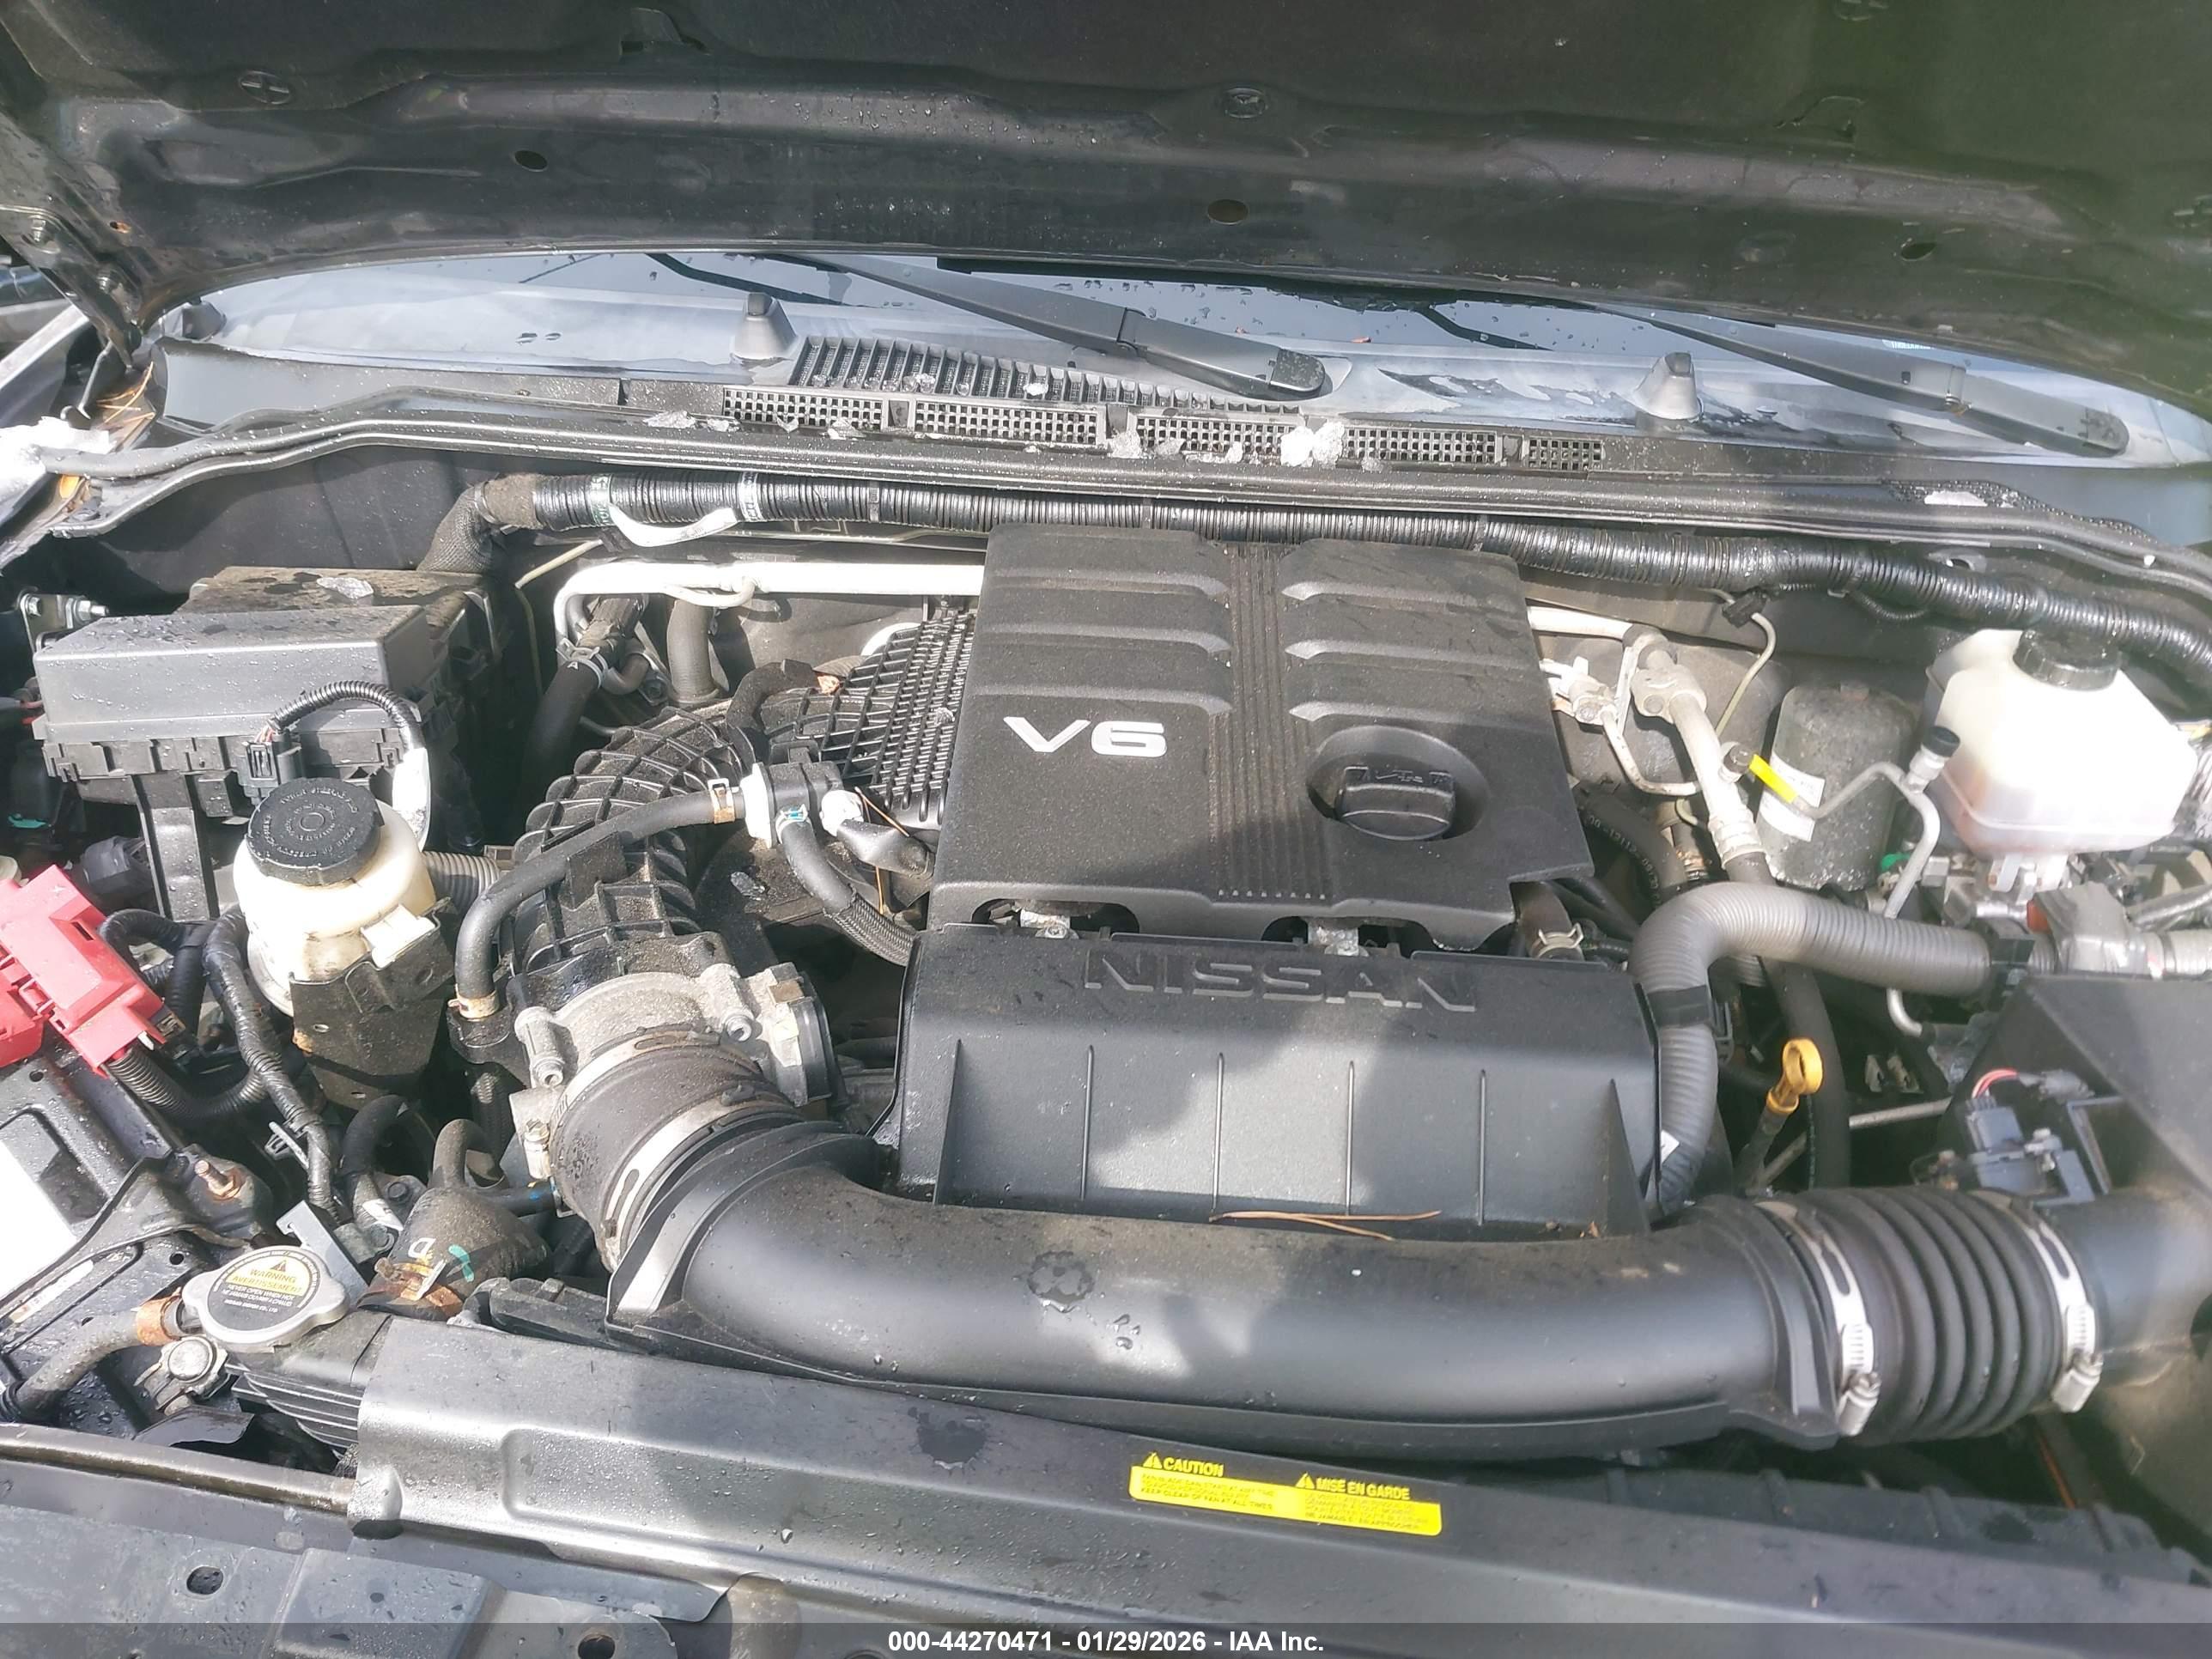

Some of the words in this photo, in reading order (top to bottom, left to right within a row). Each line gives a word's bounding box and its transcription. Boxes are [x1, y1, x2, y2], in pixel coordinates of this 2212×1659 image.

[1003, 715, 1167, 758] V6
[1085, 949, 1477, 1012] NISSAN
[232, 1275, 302, 1293] AVERTISSEMENT
[250, 1268, 296, 1283] WARNING
[1164, 1457, 1224, 1477] CAUTION
[1316, 1478, 1346, 1492] MISE
[1347, 1480, 1365, 1495] EN
[1366, 1484, 1411, 1500] GARDE
